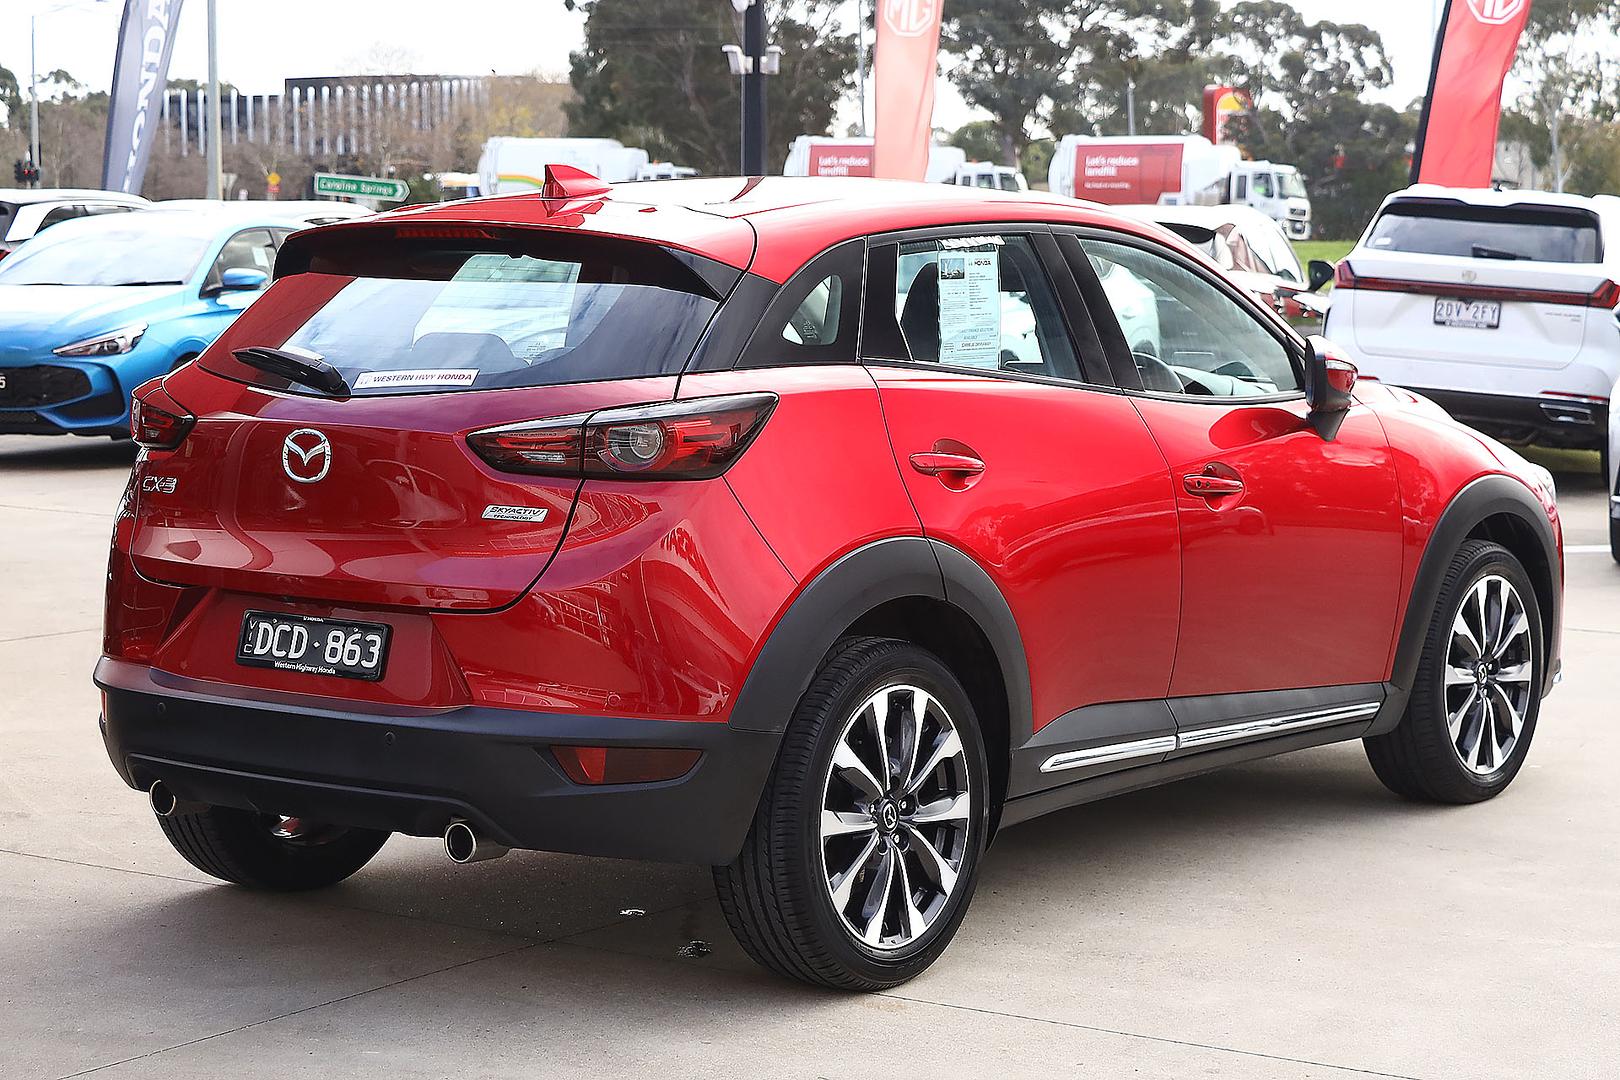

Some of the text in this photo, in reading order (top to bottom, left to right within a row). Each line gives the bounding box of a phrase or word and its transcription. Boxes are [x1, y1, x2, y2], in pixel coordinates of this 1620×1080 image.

[360, 183, 393, 196] Springs
[1471, 303, 1497, 320] 2FY
[373, 373, 472, 383] WESTERN HWY HONDA
[142, 475, 178, 494] CX-3
[489, 506, 545, 516] SKYACTIV
[253, 621, 382, 669] DCD 863
[274, 660, 336, 675] Western Highway Honda
